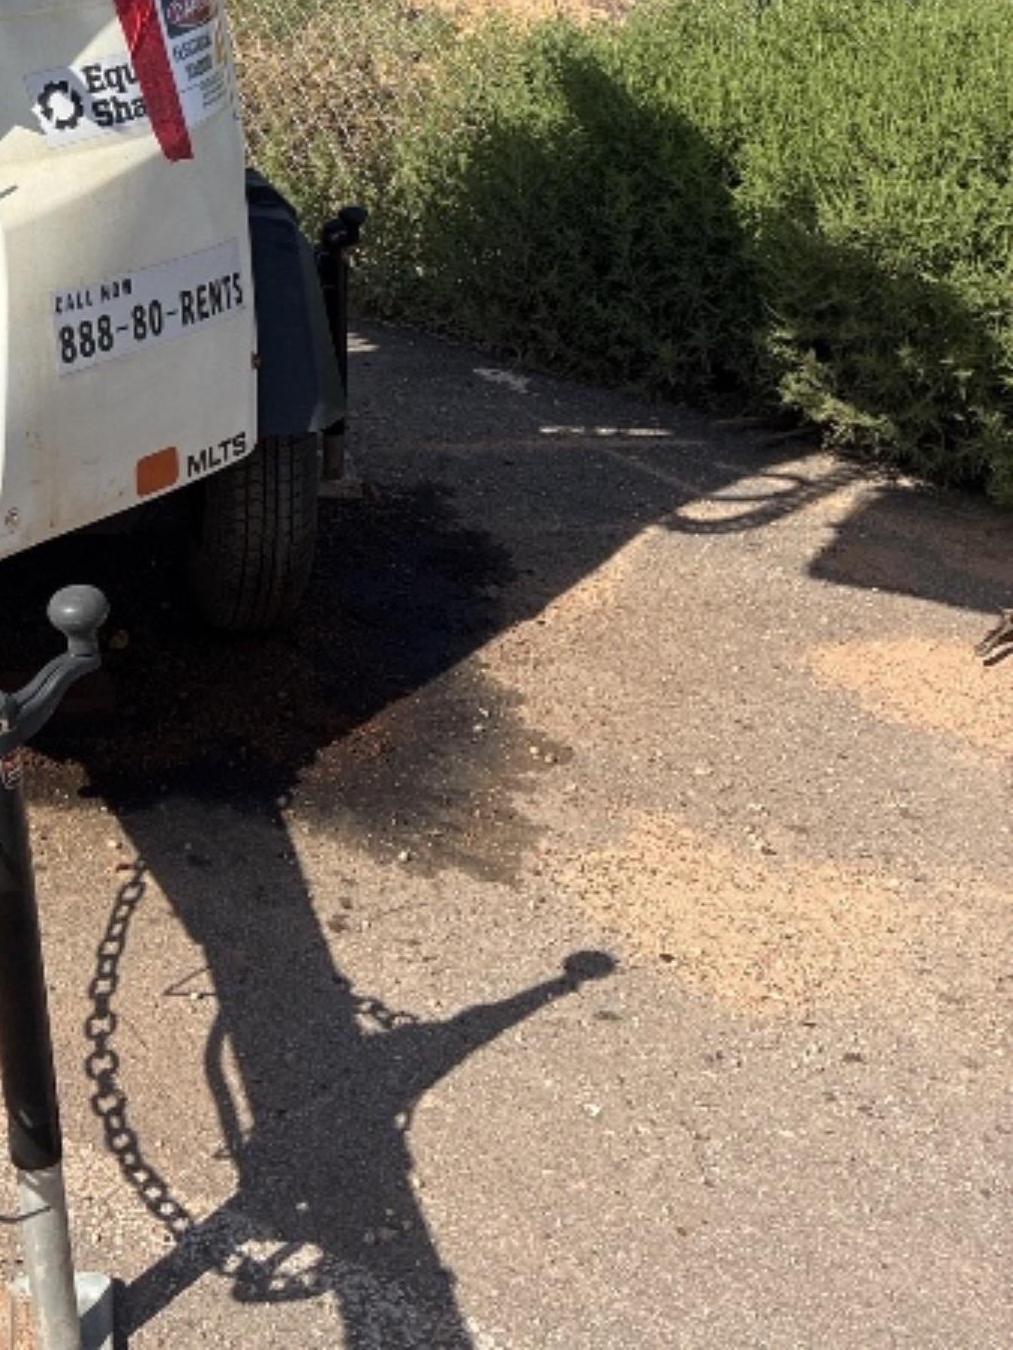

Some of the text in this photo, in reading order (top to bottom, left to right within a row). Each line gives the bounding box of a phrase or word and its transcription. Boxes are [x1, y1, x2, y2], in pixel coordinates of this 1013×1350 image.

[81, 62, 139, 94] Equ
[90, 96, 148, 127] Sha
[58, 272, 245, 364] 888-80-RENTS
[186, 431, 247, 479] MLTS
